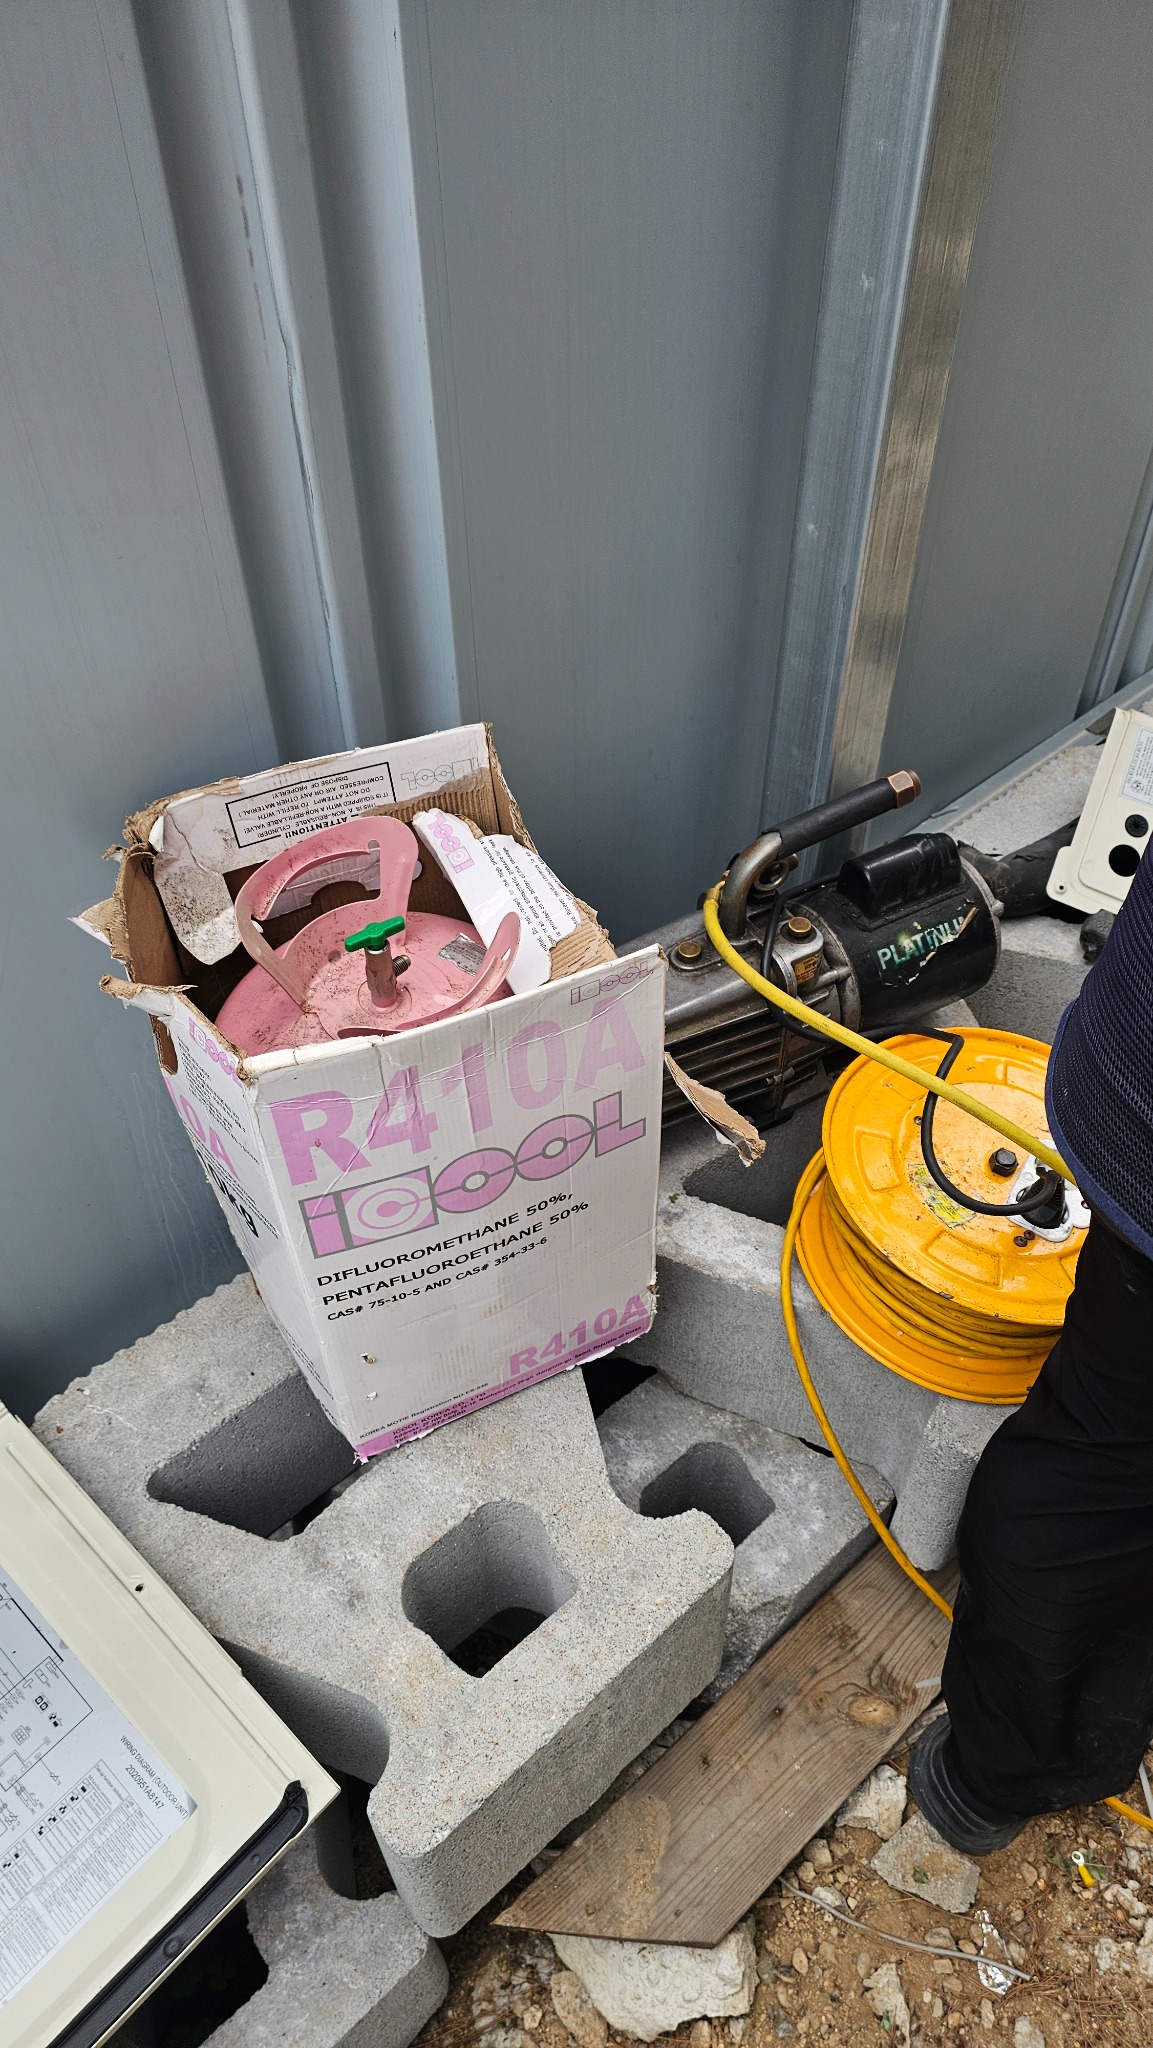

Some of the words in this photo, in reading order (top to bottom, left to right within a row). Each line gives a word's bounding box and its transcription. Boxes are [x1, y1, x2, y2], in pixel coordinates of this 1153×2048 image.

[272, 785, 307, 799] PROPERLY!
[321, 775, 348, 787] DISPOSE
[340, 775, 384, 790] COMPRESSED
[278, 796, 299, 806] OTHER
[301, 791, 313, 799] ANY
[313, 793, 343, 805] ATTEMPT
[343, 795, 375, 806] EQUIPPED
[258, 812, 275, 820] WITH
[277, 804, 299, 815] REFILL
[244, 824, 266, 834] VALVE!
[876, 916, 965, 970] PLATINU
[270, 993, 646, 1187] R410A
[317, 1212, 519, 1287] DIFLUOROMETHANE
[526, 1191, 574, 1218] 50%,
[322, 1220, 544, 1306] PENTAFLUOROETHANE
[549, 1200, 589, 1227] 50%
[327, 1305, 364, 1322] CAS#
[368, 1287, 422, 1310] 75-10-5
[424, 1276, 452, 1296] AND
[454, 1263, 491, 1282] CAS#
[494, 1236, 549, 1267] 354-33-6
[509, 1295, 649, 1377] R410A
[593, 1338, 617, 1350] Republic
[625, 1326, 641, 1336] Korea
[360, 1426, 386, 1439] KOREA
[387, 1415, 410, 1427] MOTIE
[411, 1398, 452, 1418] Registration
[421, 1408, 450, 1422] KOREA
[471, 1392, 486, 1401] LTD
[120, 1735, 137, 1755] WIRING
[135, 1752, 157, 1778] DIAGRAM
[153, 1777, 178, 1807] (OUTDOOR
[174, 1801, 189, 1820] UNIT)
[126, 1764, 165, 1810] 2020951A8147
